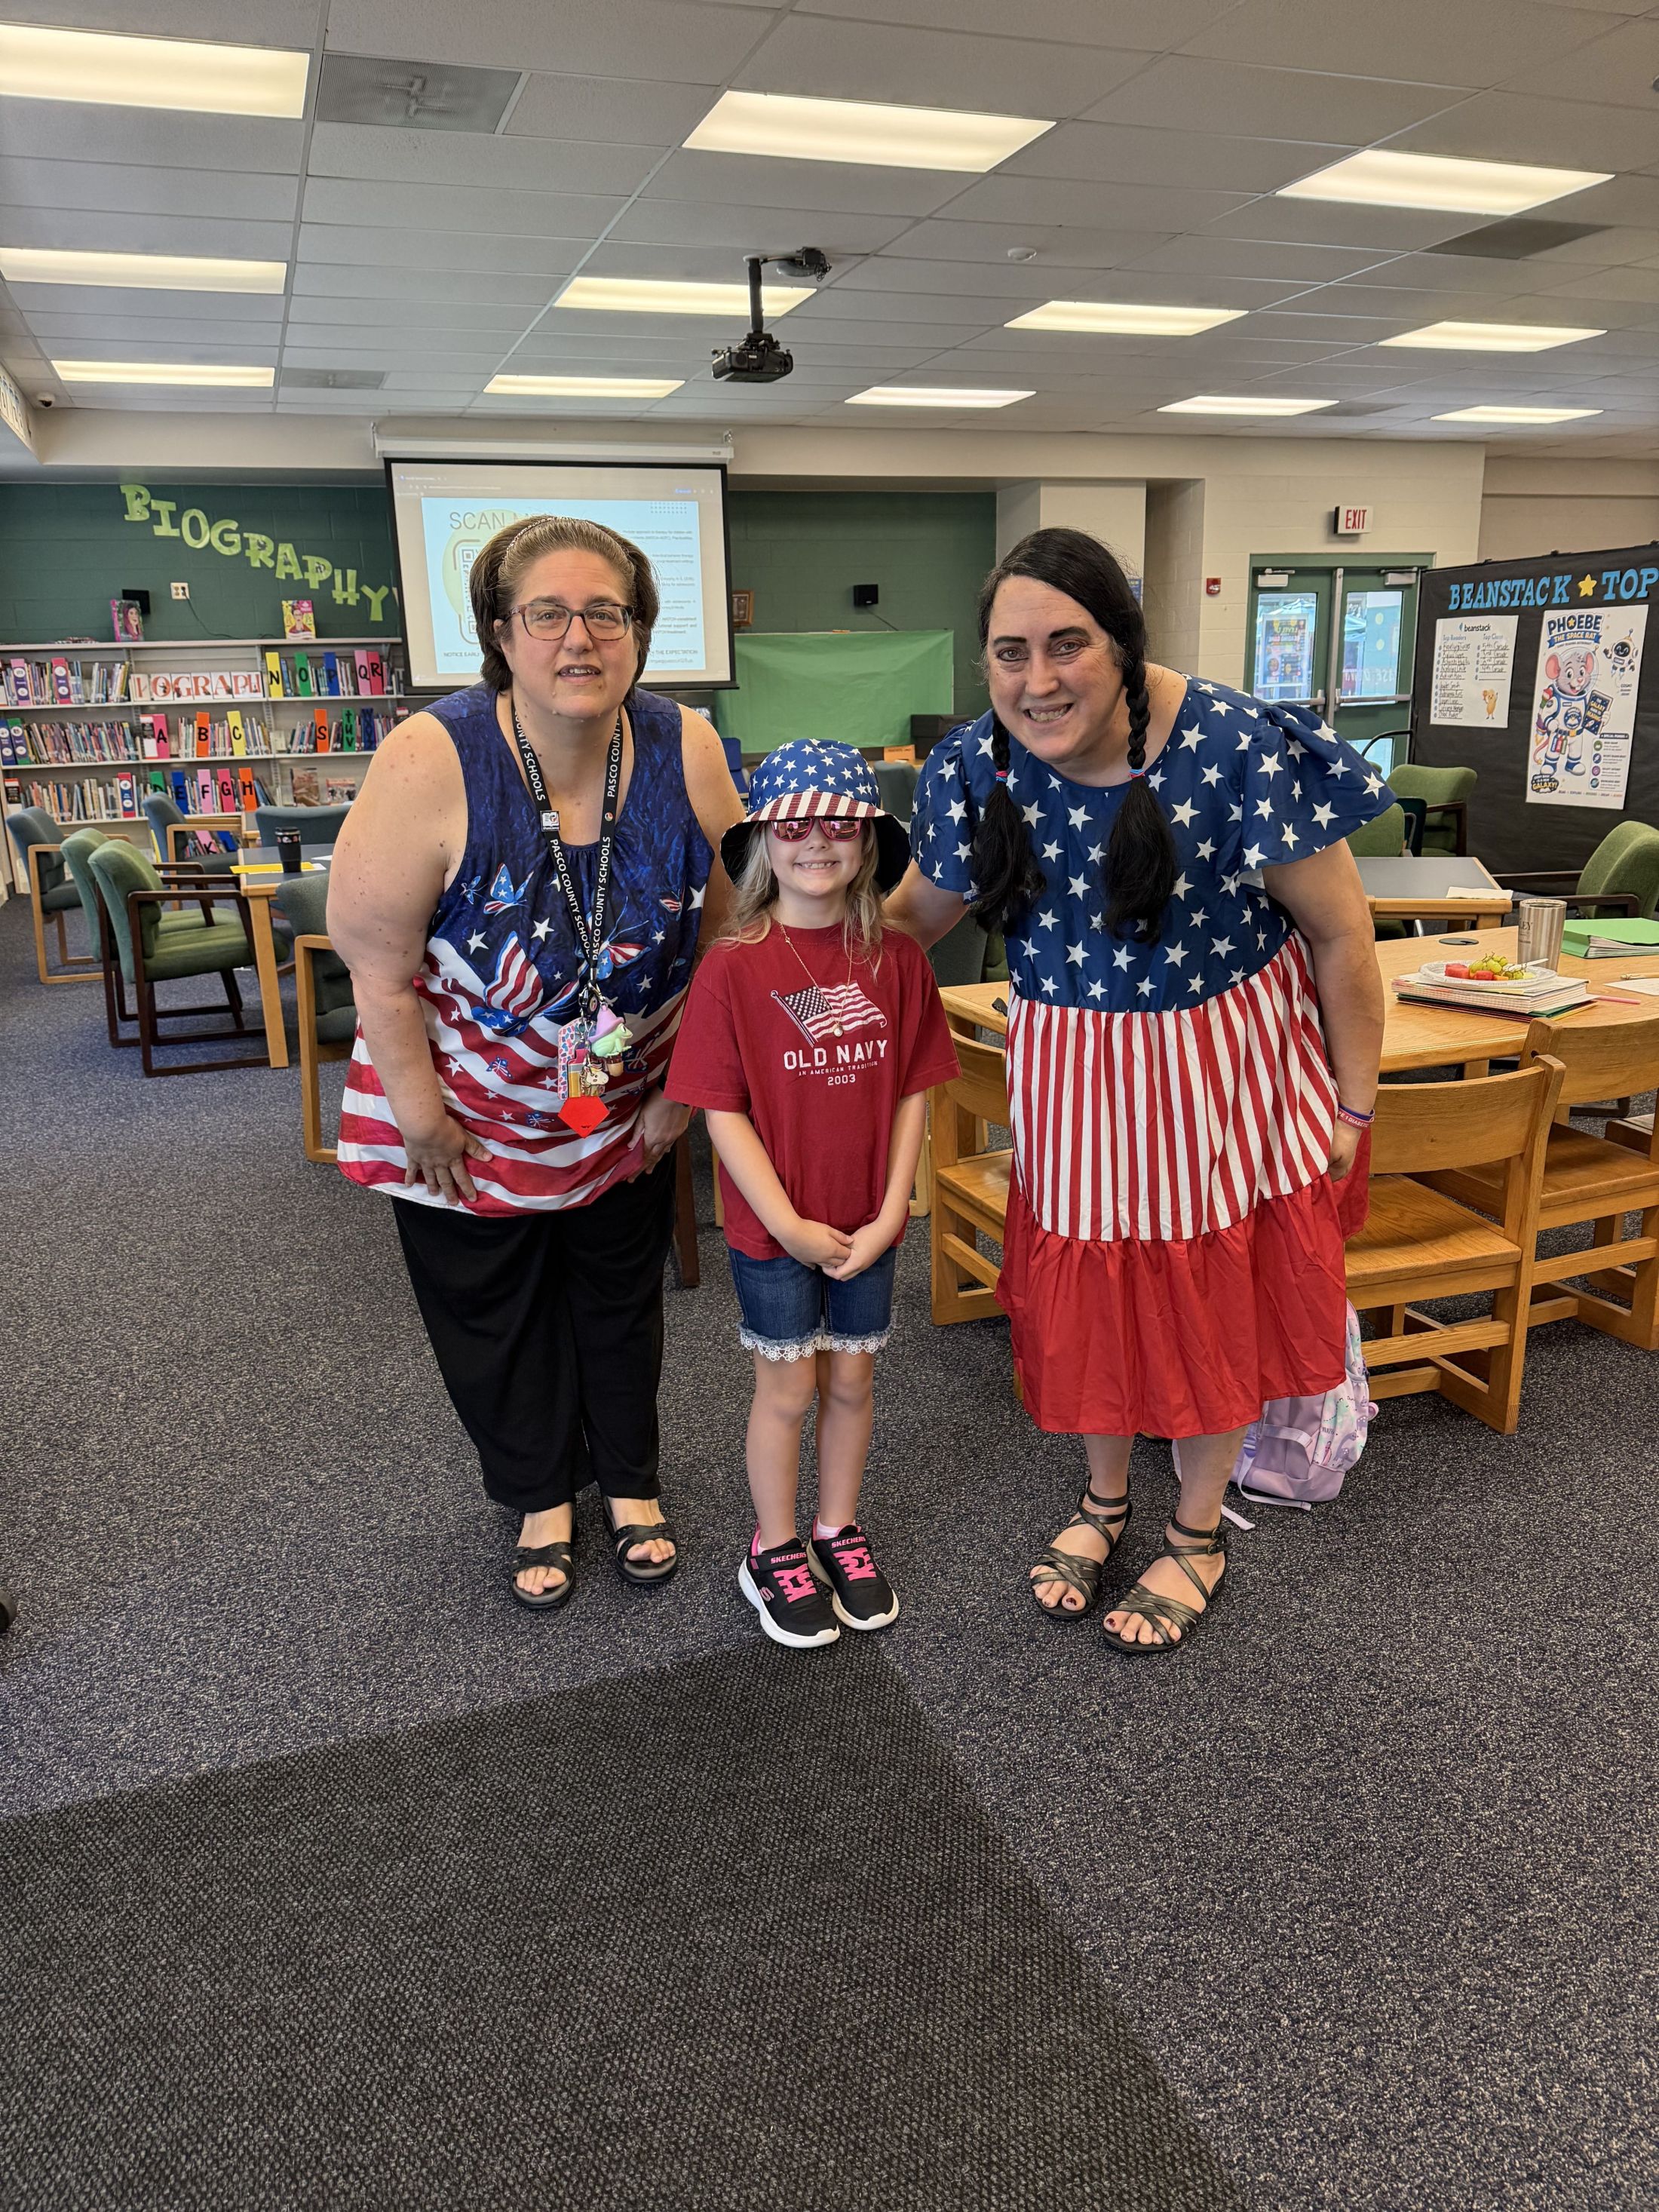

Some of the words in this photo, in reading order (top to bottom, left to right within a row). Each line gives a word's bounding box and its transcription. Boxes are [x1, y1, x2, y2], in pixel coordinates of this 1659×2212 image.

[449, 511, 505, 530] SCAN
[1345, 509, 1367, 529] EXIT
[121, 485, 389, 621] BIOGRAPHY
[1448, 575, 1572, 610] BEANSTACK
[1602, 567, 1659, 600] TOP
[1464, 624, 1491, 632] beanstack
[1547, 614, 1603, 635] PHOEBE
[268, 670, 280, 685] N
[299, 667, 308, 682] O
[358, 664, 370, 680] Q
[370, 663, 382, 677] R
[157, 729, 167, 744] A
[198, 726, 209, 741] B
[232, 726, 242, 741] C
[317, 726, 327, 740] S
[514, 710, 531, 750] OUNTY
[524, 752, 546, 801] SCHOOLS
[221, 781, 232, 796] G
[242, 781, 253, 796] H
[607, 764, 618, 798] PASCO
[201, 784, 210, 799] F
[599, 836, 611, 884] SCHOOLS
[550, 839, 566, 872] PASCO
[561, 873, 580, 913] COUNTY
[594, 885, 606, 927] COUNTY
[593, 928, 601, 961] PASCO
[784, 1048, 827, 1070] OLD
[836, 1039, 888, 1064] NAVY
[810, 1066, 844, 1075] AMERICAN
[848, 1060, 878, 1072] TRADITION
[827, 1073, 856, 1086] 2003
[831, 1536, 866, 1548] SKECHERS
[770, 1551, 807, 1564] SKECHERS
